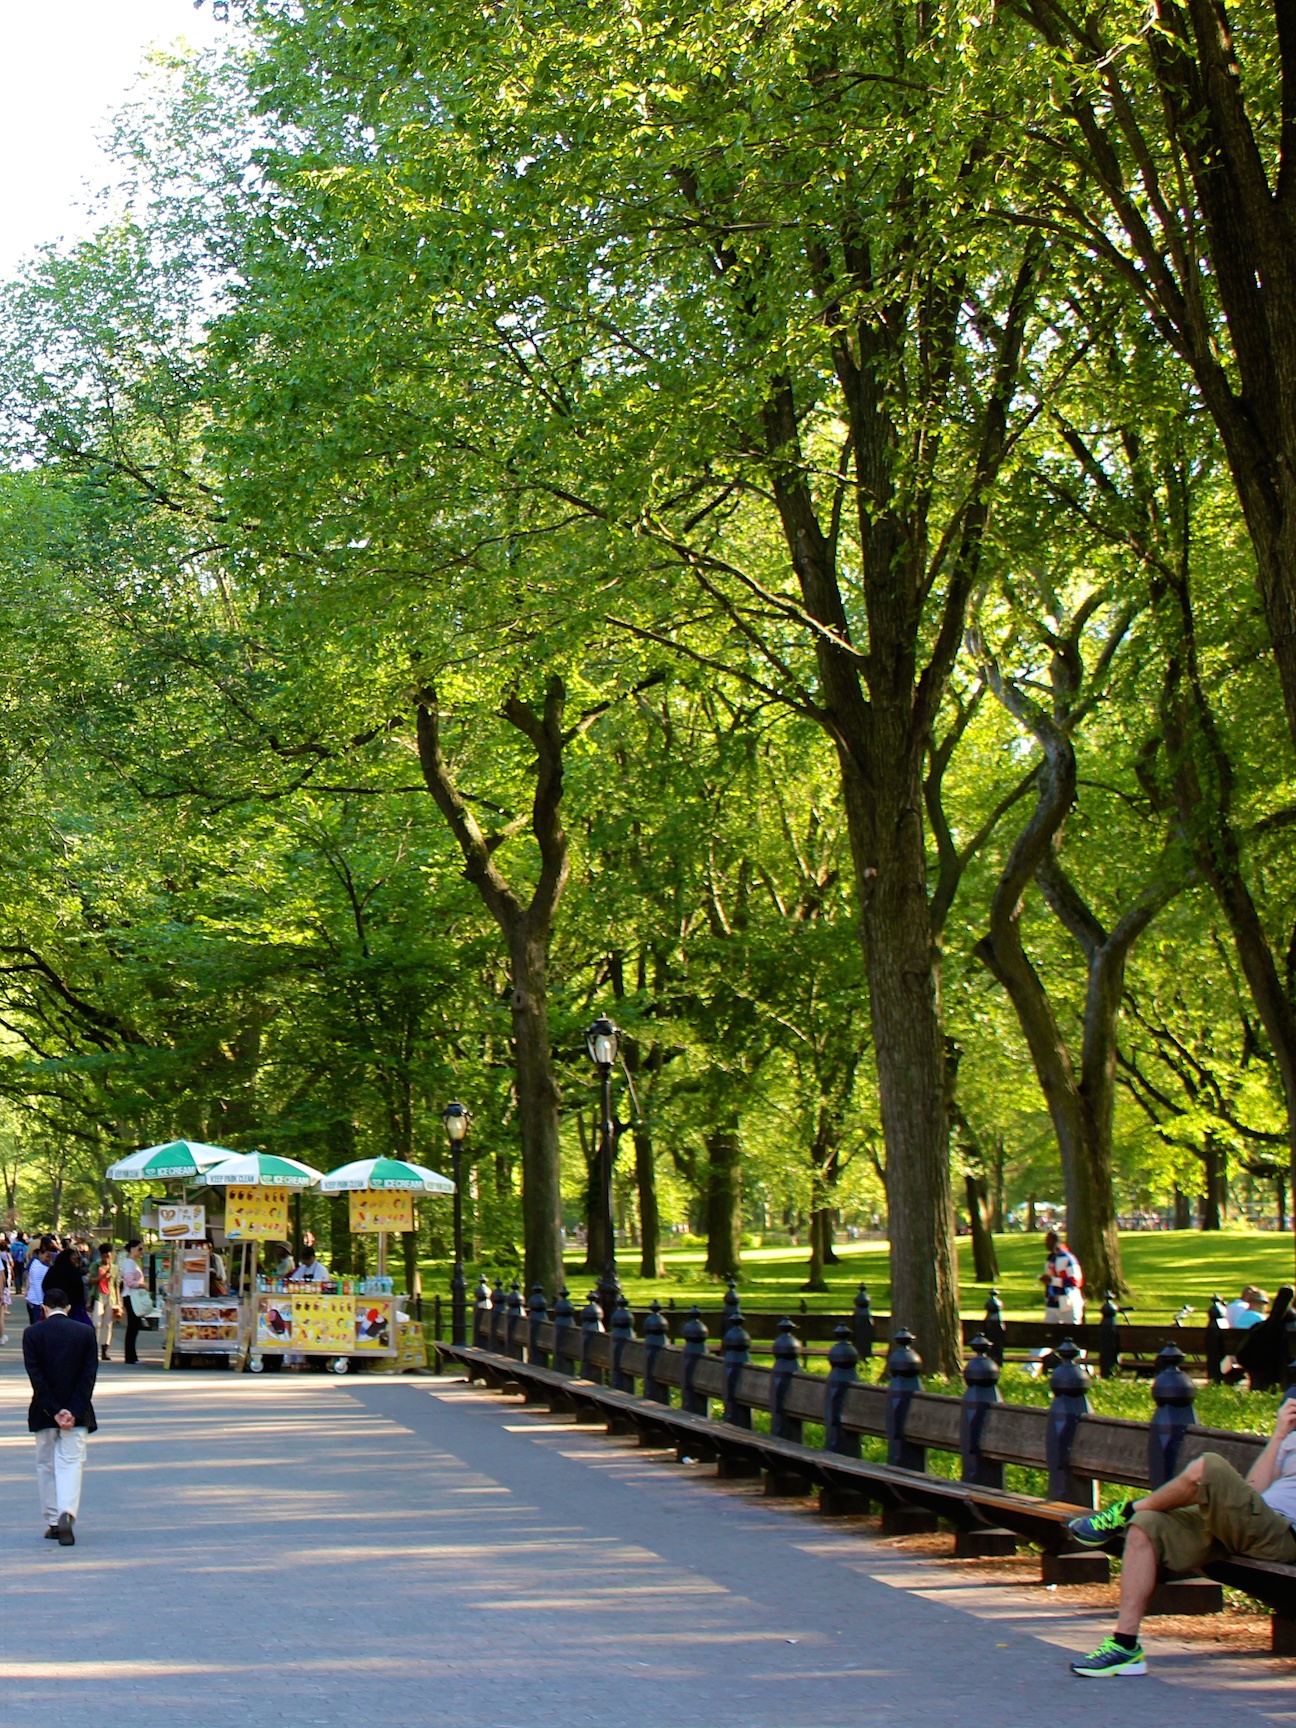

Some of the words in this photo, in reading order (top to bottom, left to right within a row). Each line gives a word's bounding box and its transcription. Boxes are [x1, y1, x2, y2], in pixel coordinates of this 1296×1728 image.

[211, 1175, 223, 1183] KEEP
[224, 1175, 237, 1183] PARK
[238, 1175, 254, 1183] CLEAN
